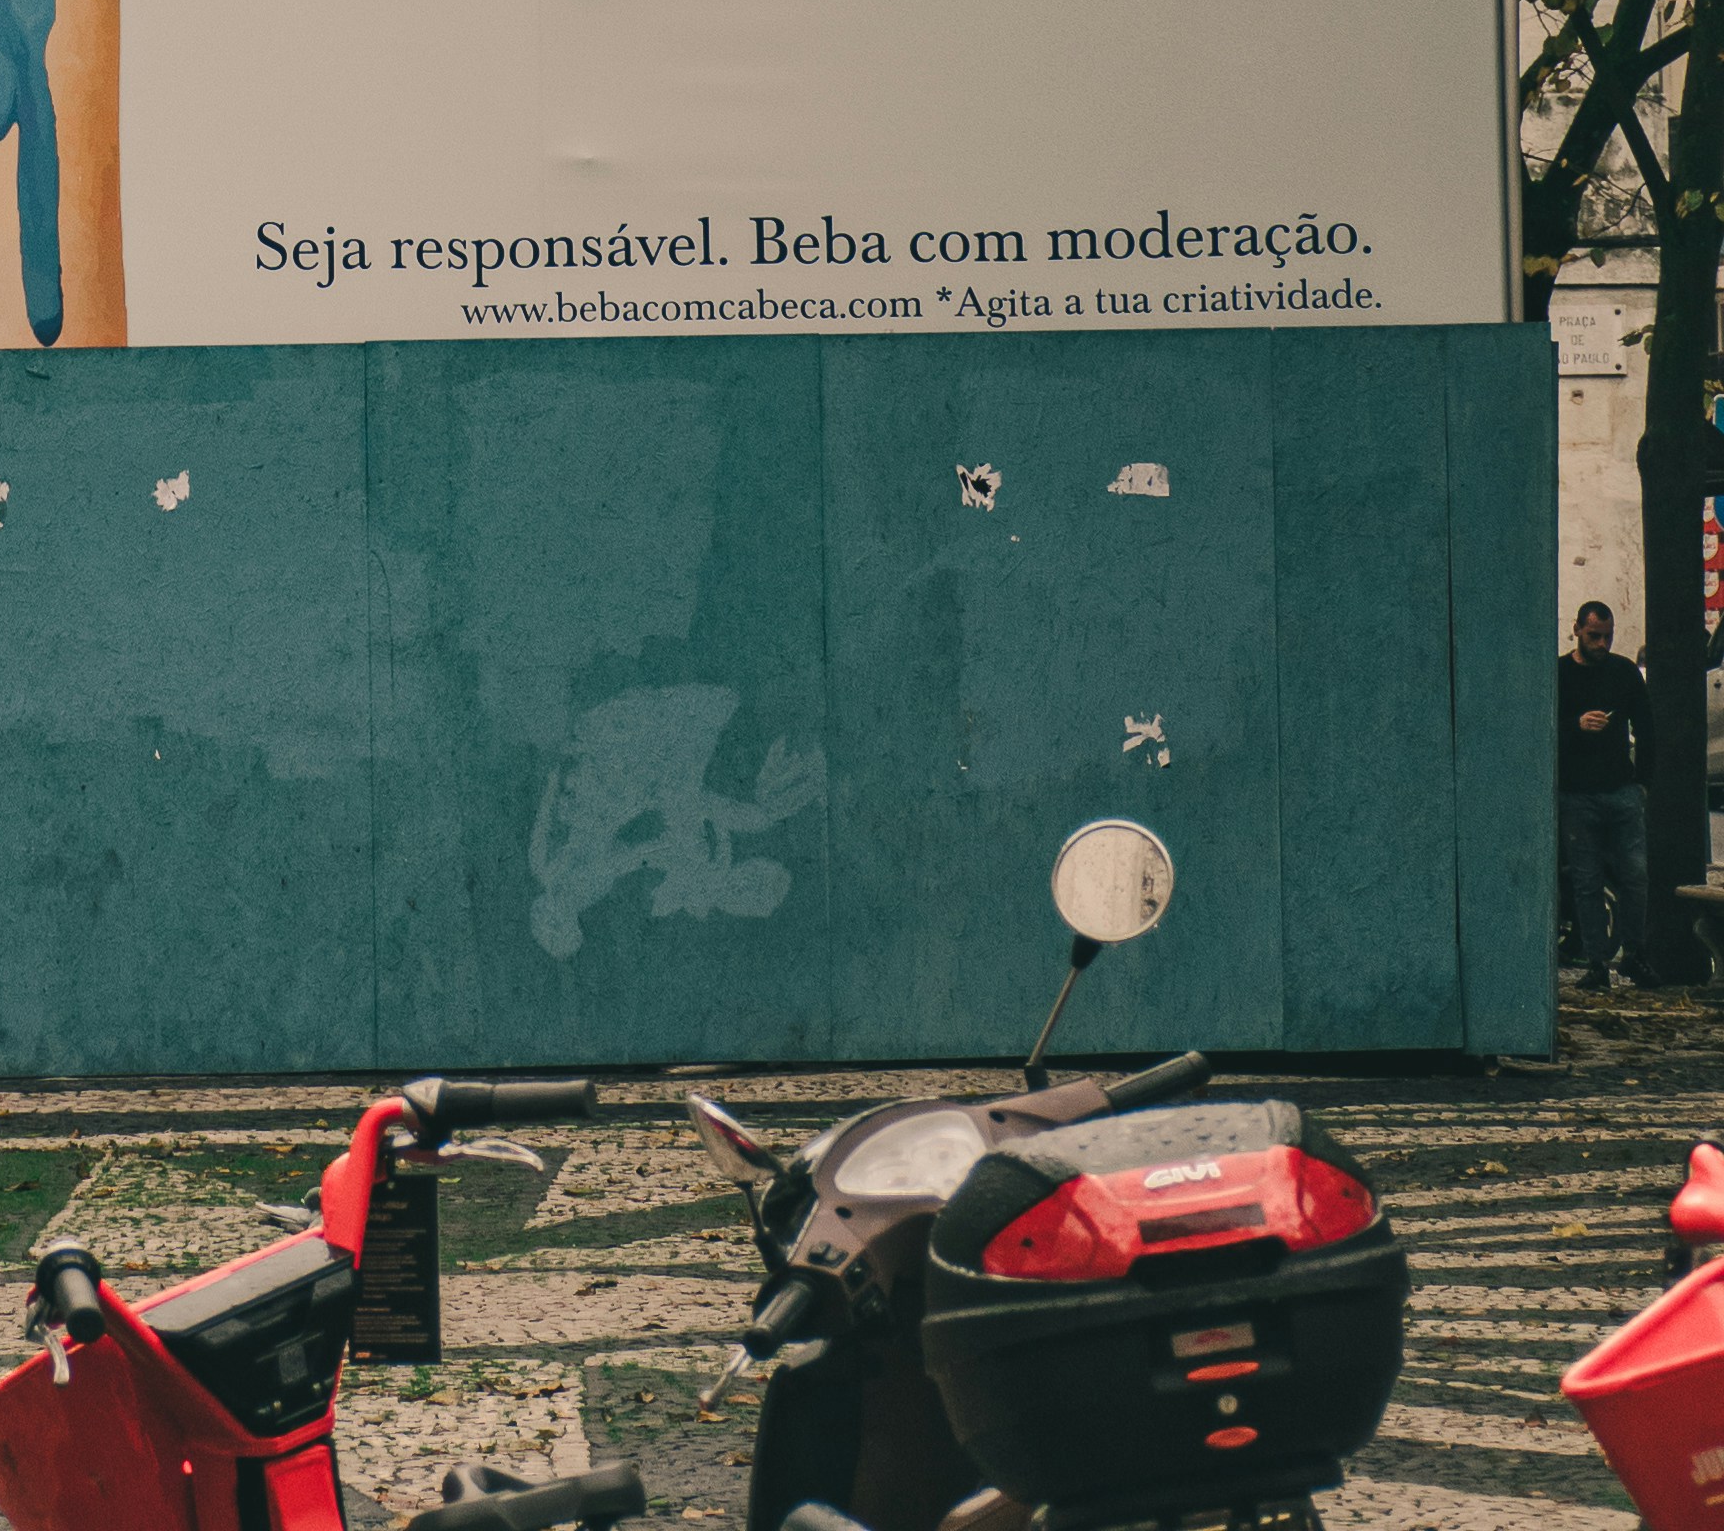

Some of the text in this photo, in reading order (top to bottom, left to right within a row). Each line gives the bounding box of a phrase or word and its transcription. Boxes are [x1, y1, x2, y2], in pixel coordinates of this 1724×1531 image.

[256, 209, 1374, 289] Seja responsável. Beba com moderação.
[460, 288, 923, 325] www.bebacomcabeca.com
[1064, 294, 1086, 316] a
[1095, 288, 1153, 315] tua
[1163, 277, 1384, 314] criatividade.
[1559, 316, 1596, 330] PRAÇA
[1571, 334, 1585, 346] DE
[1573, 352, 1610, 365] PAULO
[1143, 1161, 1222, 1190] GIVI
